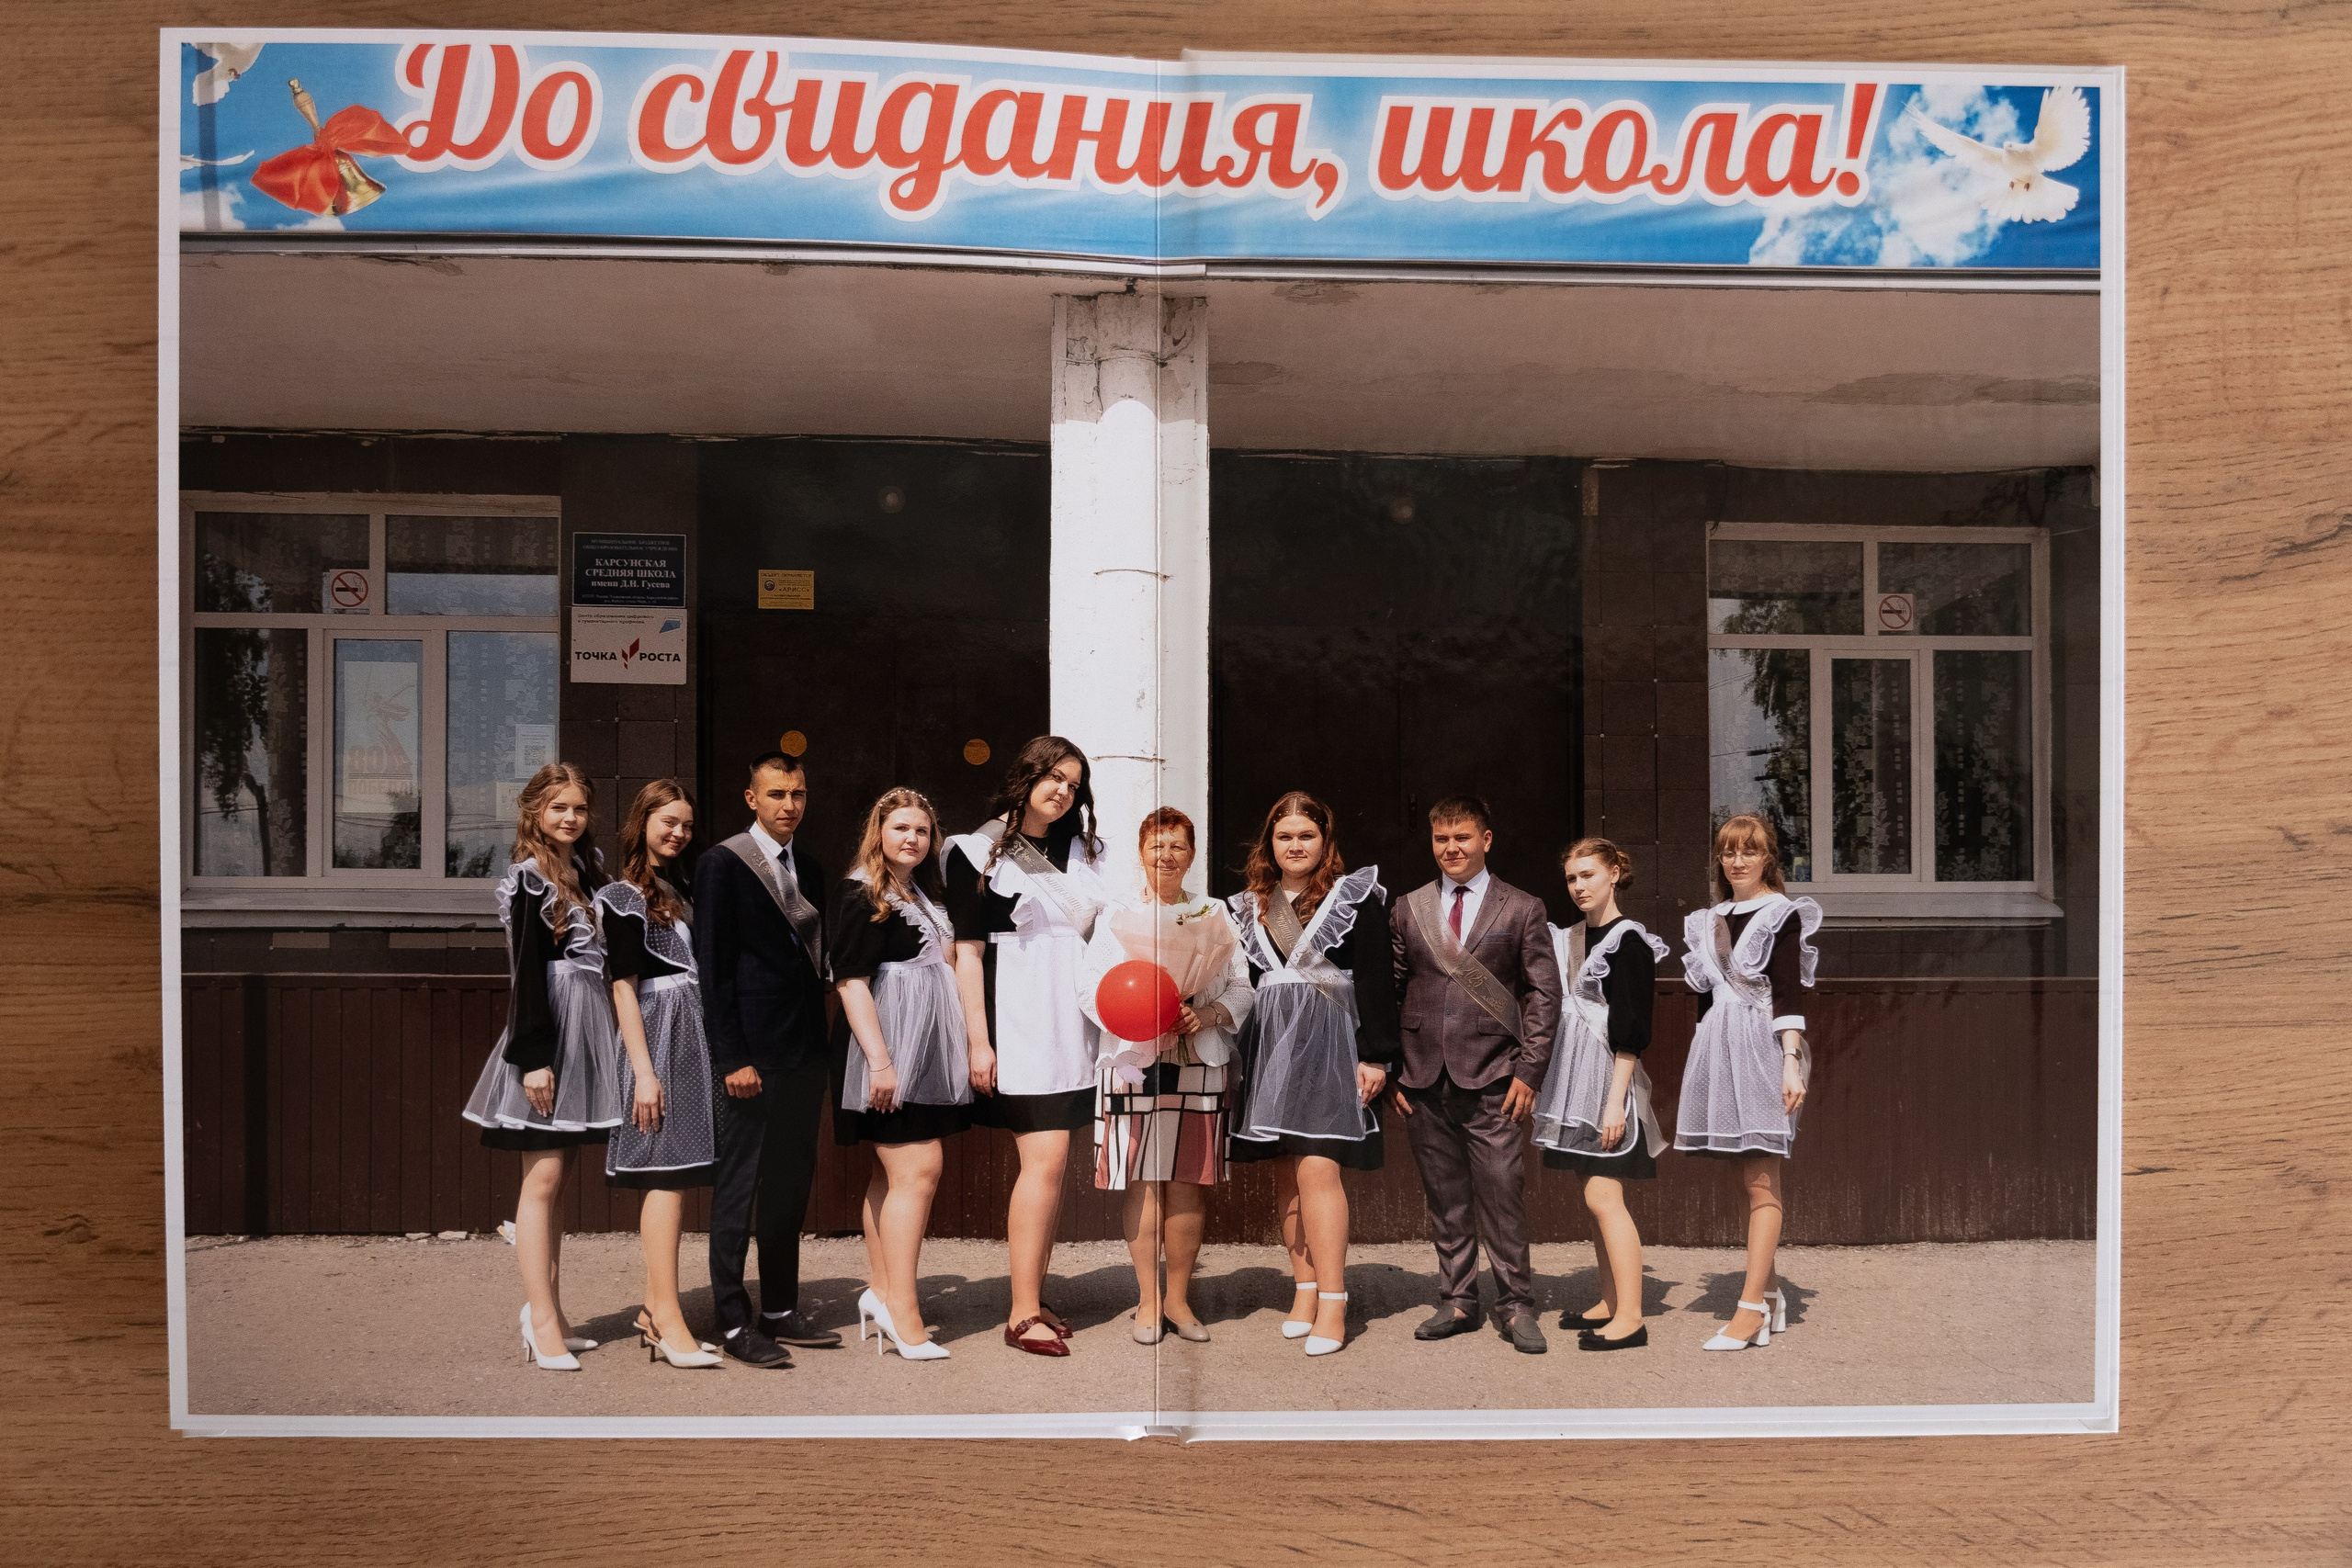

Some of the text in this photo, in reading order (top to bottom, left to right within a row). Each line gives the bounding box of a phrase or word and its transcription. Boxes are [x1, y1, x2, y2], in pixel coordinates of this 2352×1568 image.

[401, 43, 1879, 213] До свидания, школа!
[595, 558, 667, 568] КАРСУНСКАЯ
[585, 569, 676, 579] СРЕДНЯЯ ШКОЛА
[619, 580, 639, 588] Д.Н.
[641, 581, 671, 589] Гусева
[575, 651, 681, 661] ТОЧКА РОСТА
